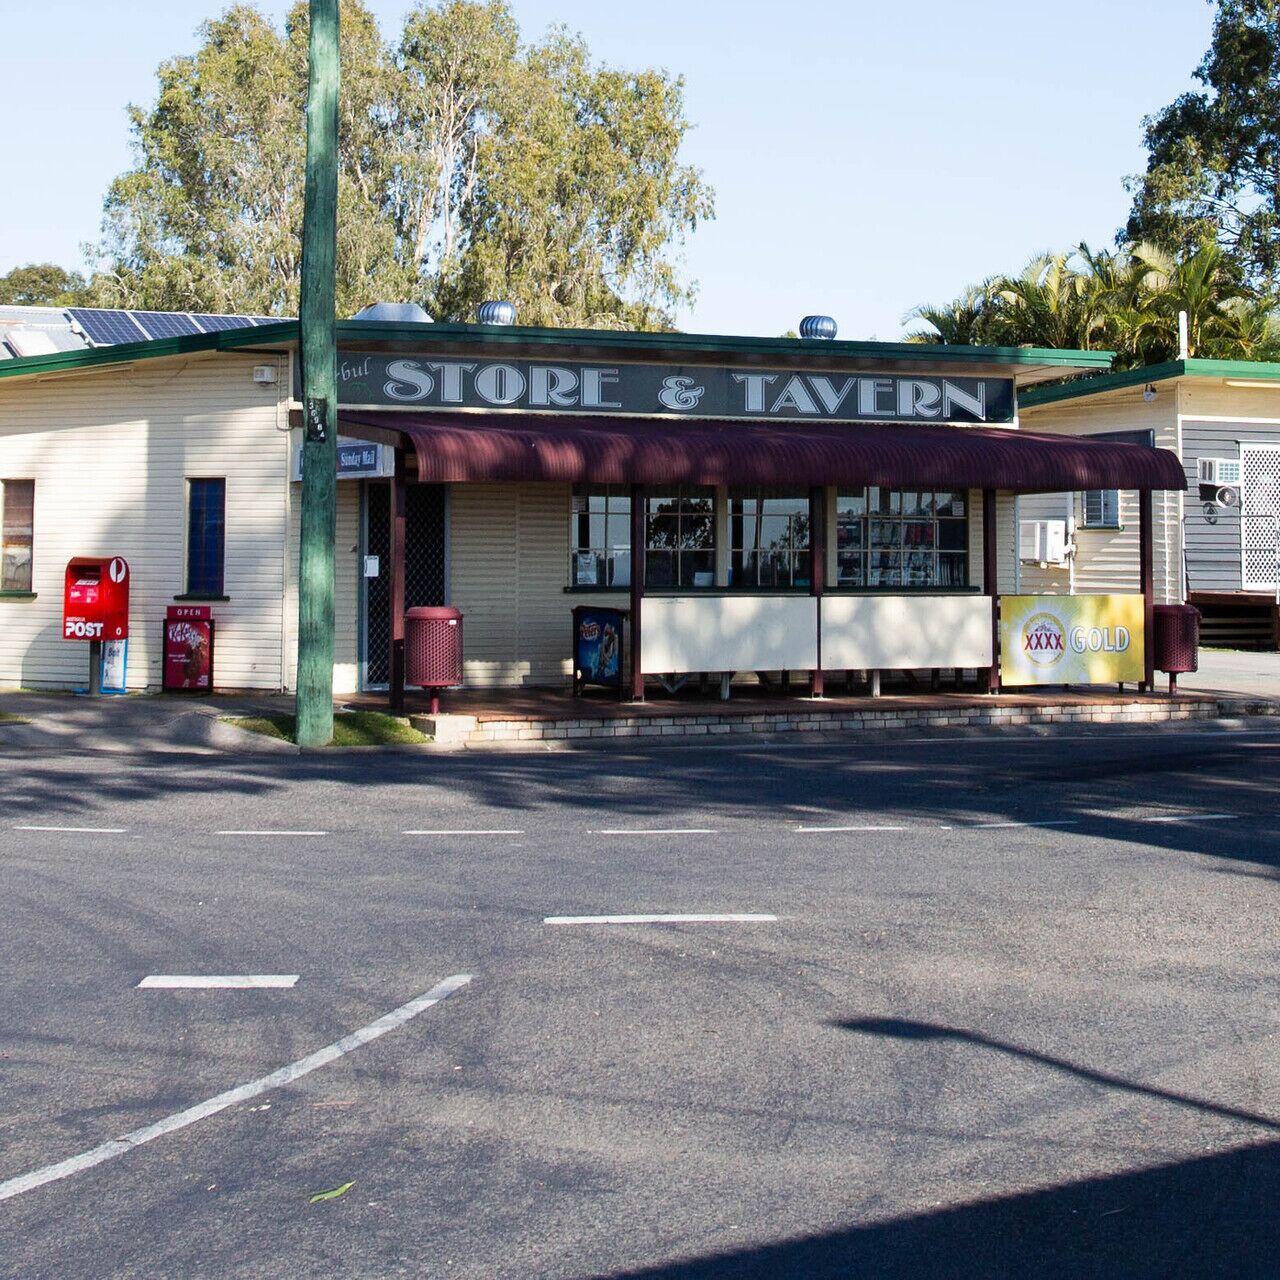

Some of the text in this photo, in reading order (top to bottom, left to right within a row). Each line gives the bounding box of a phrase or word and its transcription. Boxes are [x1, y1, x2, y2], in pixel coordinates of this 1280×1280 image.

[383, 359, 986, 421] STORE & TAVERN
[341, 450, 376, 467] Sunday Mail
[65, 622, 104, 637] POST
[1024, 625, 1130, 654] XXXX GOLD
